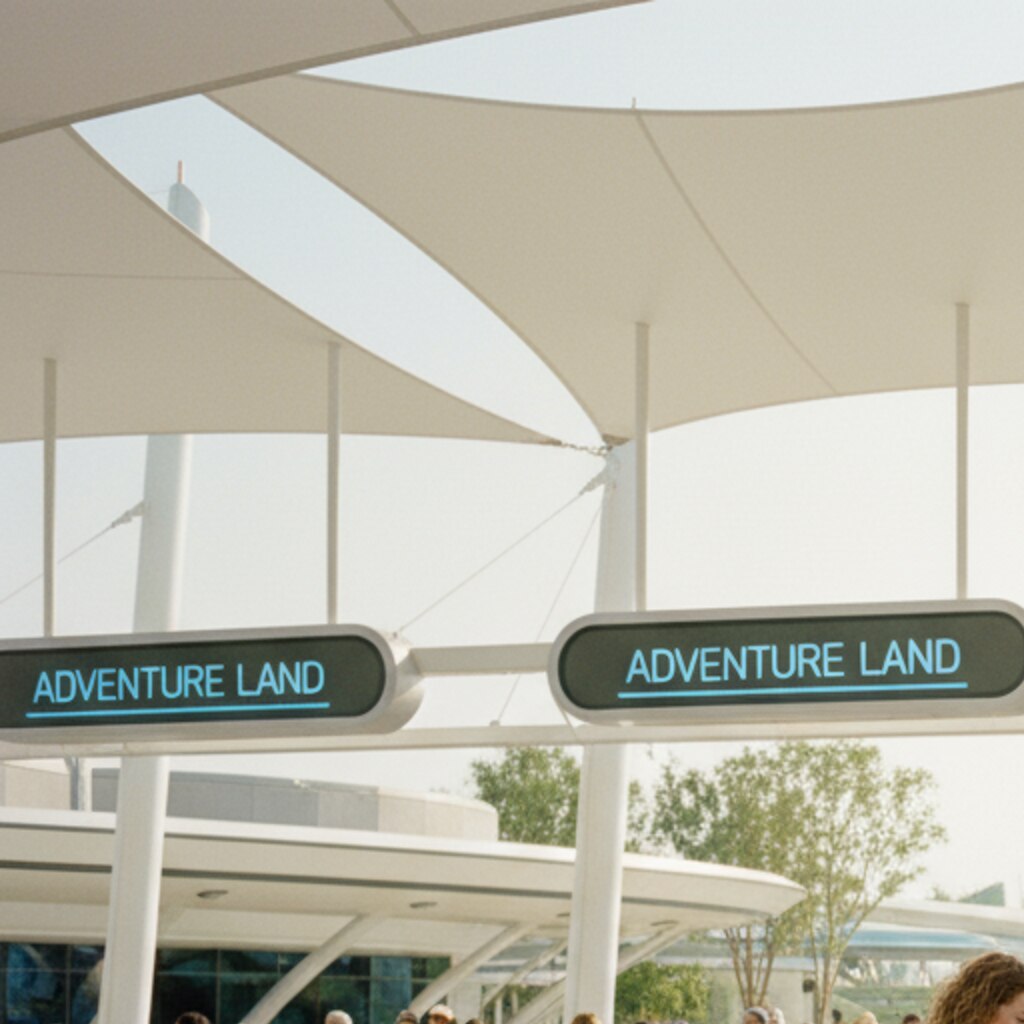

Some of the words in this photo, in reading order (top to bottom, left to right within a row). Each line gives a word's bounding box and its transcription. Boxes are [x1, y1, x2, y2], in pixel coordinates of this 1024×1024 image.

[34, 664, 224, 703] ADVENTURE
[238, 660, 325, 696] LAND
[626, 642, 845, 683] ADVENTURE
[860, 638, 961, 677] LAND
